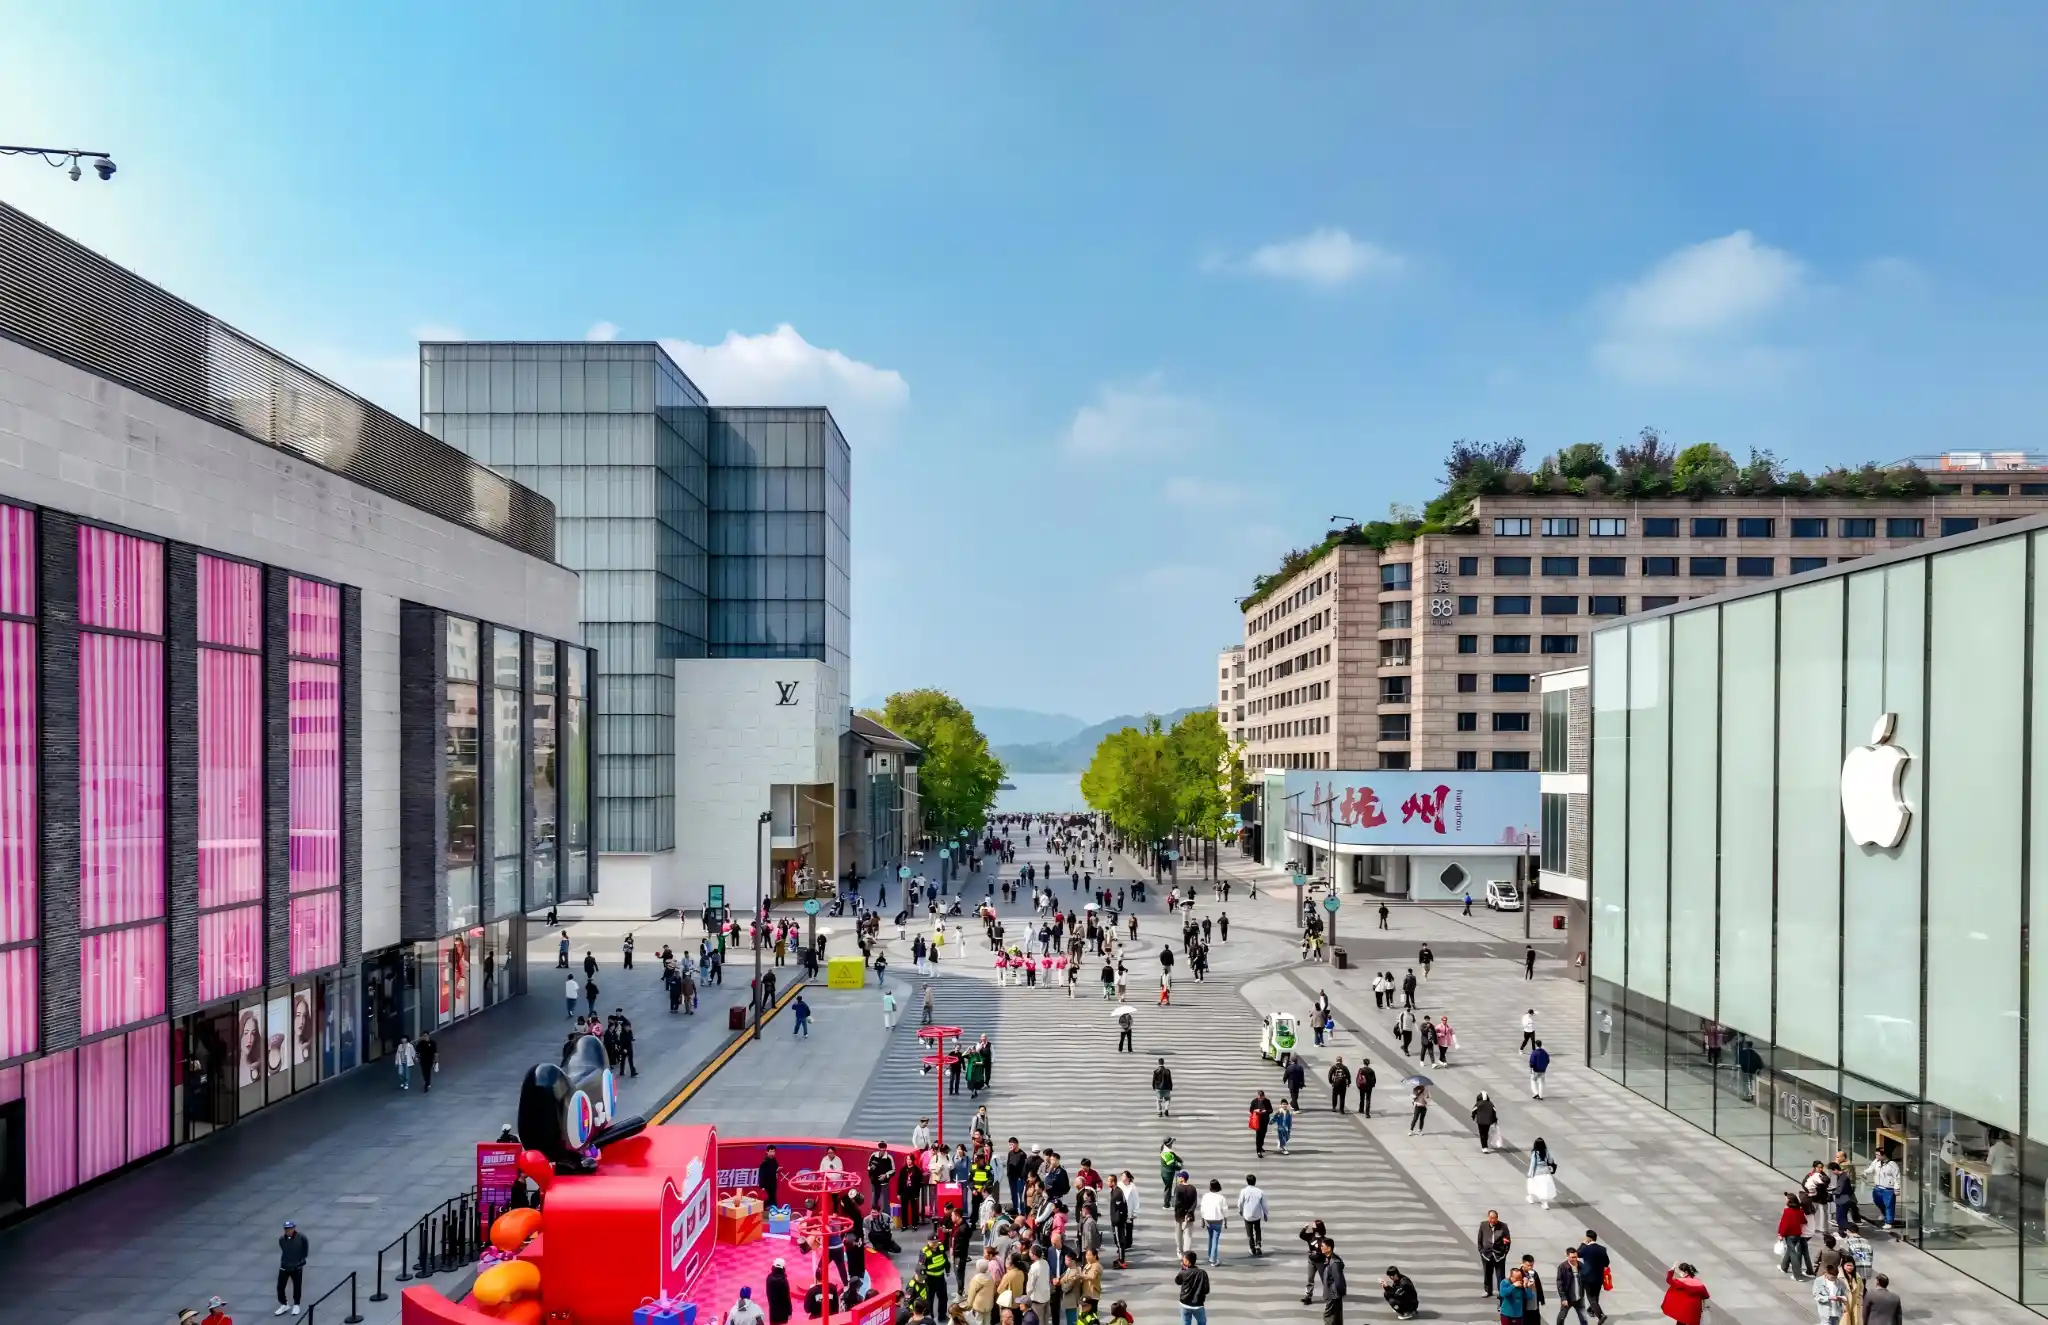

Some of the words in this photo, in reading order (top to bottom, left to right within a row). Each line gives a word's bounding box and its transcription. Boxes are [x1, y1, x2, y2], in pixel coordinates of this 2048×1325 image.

[1431, 598, 1453, 617] 88
[1340, 784, 1451, 834] 杭州
[1454, 789, 1464, 832] hangzhou
[1780, 1091, 1800, 1122] 16
[1801, 1098, 1830, 1136] Pro
